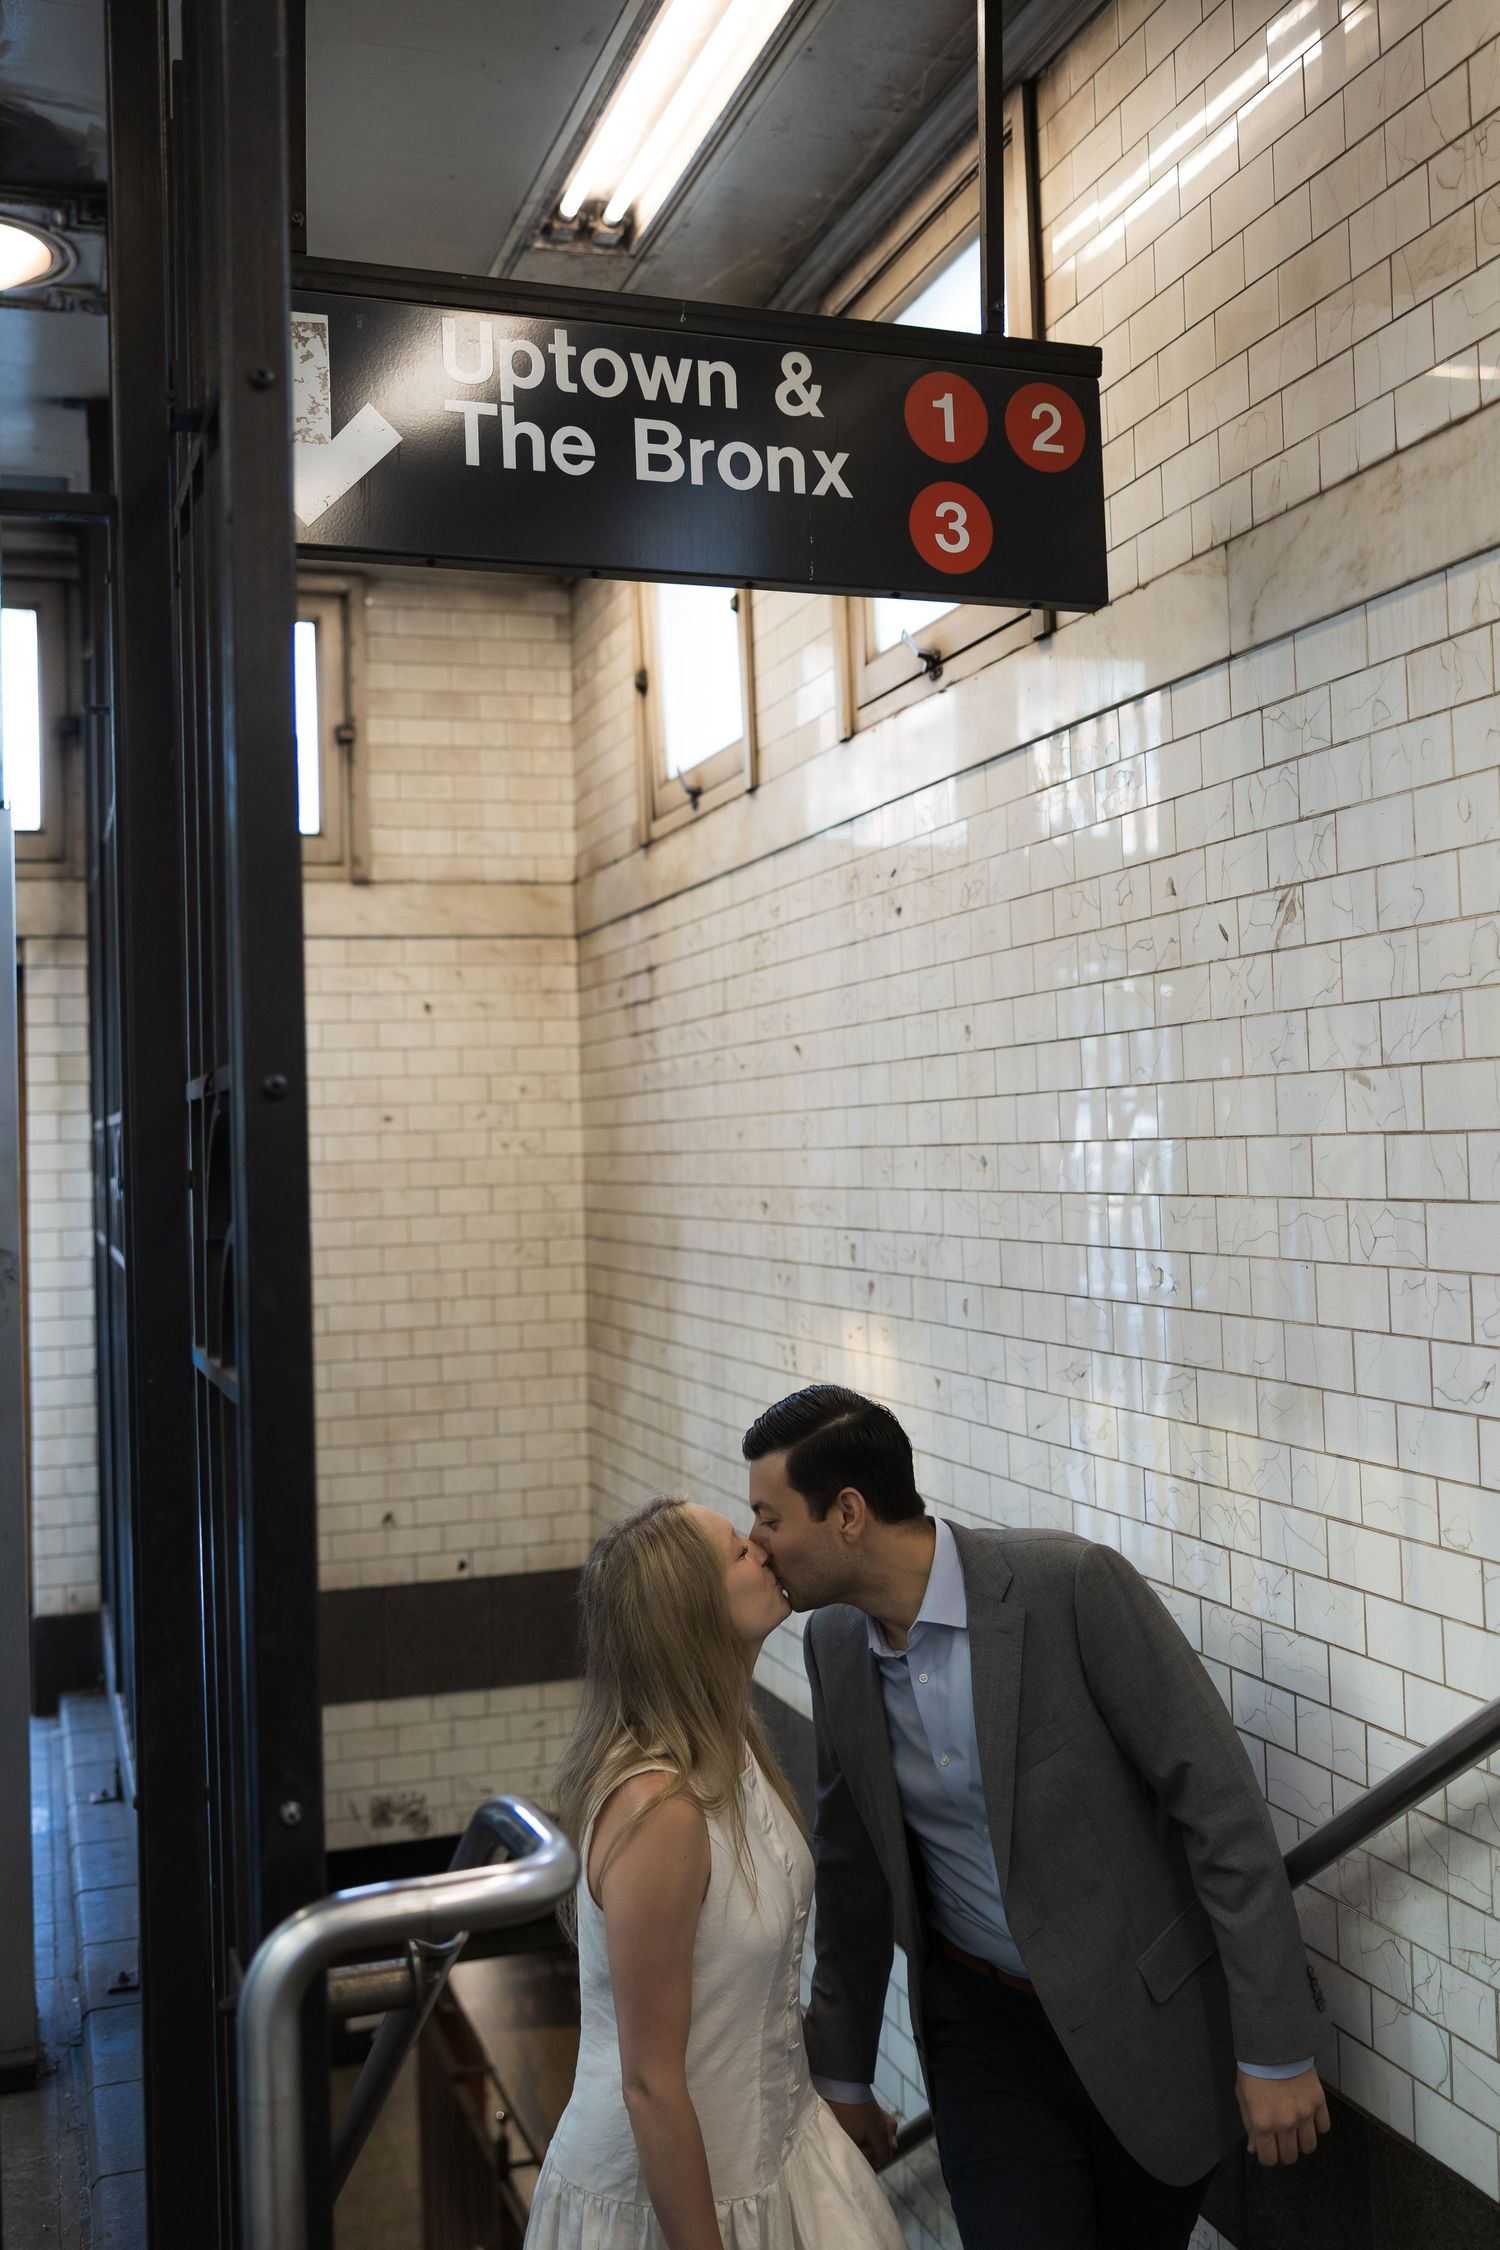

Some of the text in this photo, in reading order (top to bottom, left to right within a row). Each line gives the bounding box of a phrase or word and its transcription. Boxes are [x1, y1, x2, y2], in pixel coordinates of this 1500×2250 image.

[441, 316, 824, 417] Uptown &
[446, 402, 854, 499] The Bronx
[932, 393, 1064, 453] 1 2
[934, 501, 970, 553] 3
